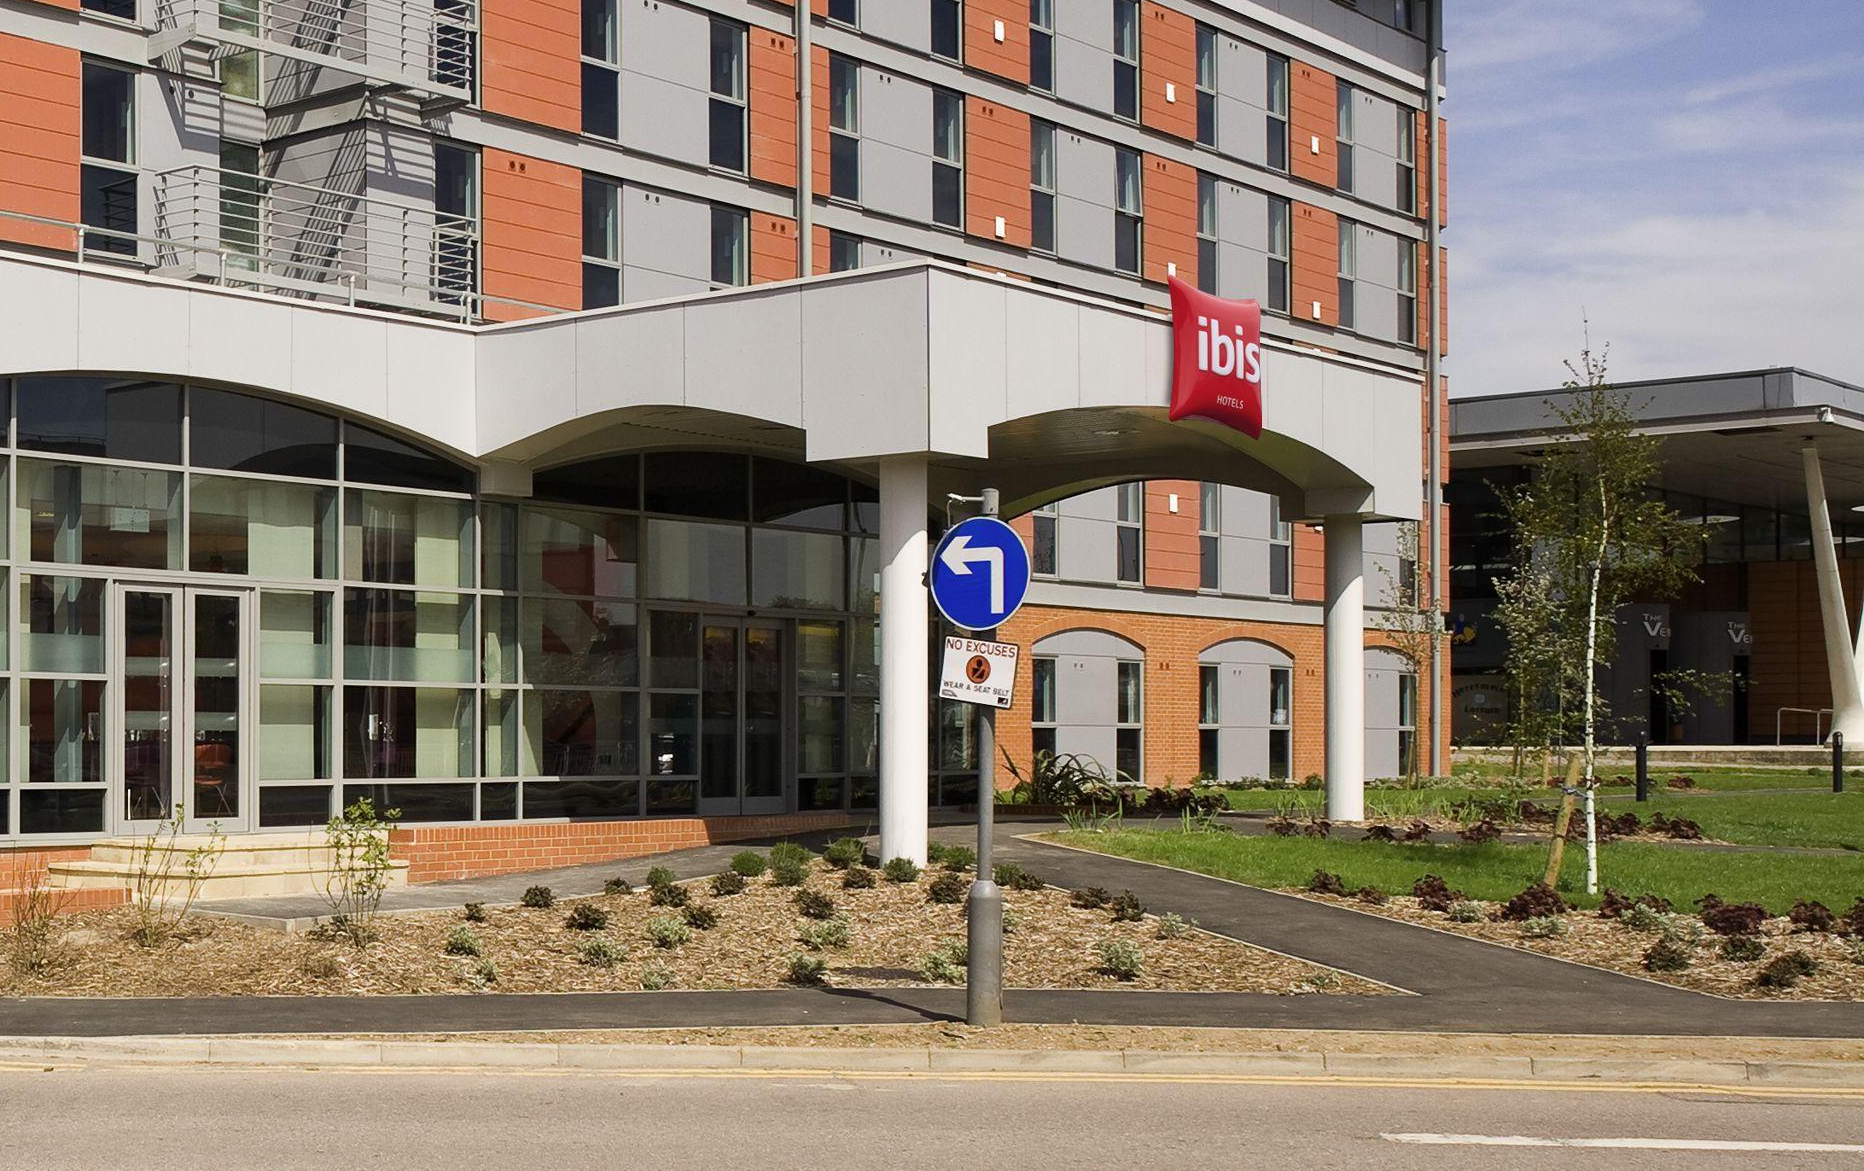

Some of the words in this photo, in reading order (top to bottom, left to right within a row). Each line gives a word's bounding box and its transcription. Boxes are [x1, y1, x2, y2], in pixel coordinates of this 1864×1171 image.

[1198, 315, 1261, 384] ibis
[1216, 394, 1244, 410] HOTELS
[946, 637, 962, 650] NO
[966, 640, 1016, 658] EXCUSES
[943, 680, 964, 689] WEAR
[974, 685, 991, 694] SEAT
[993, 688, 1009, 697] BELT
